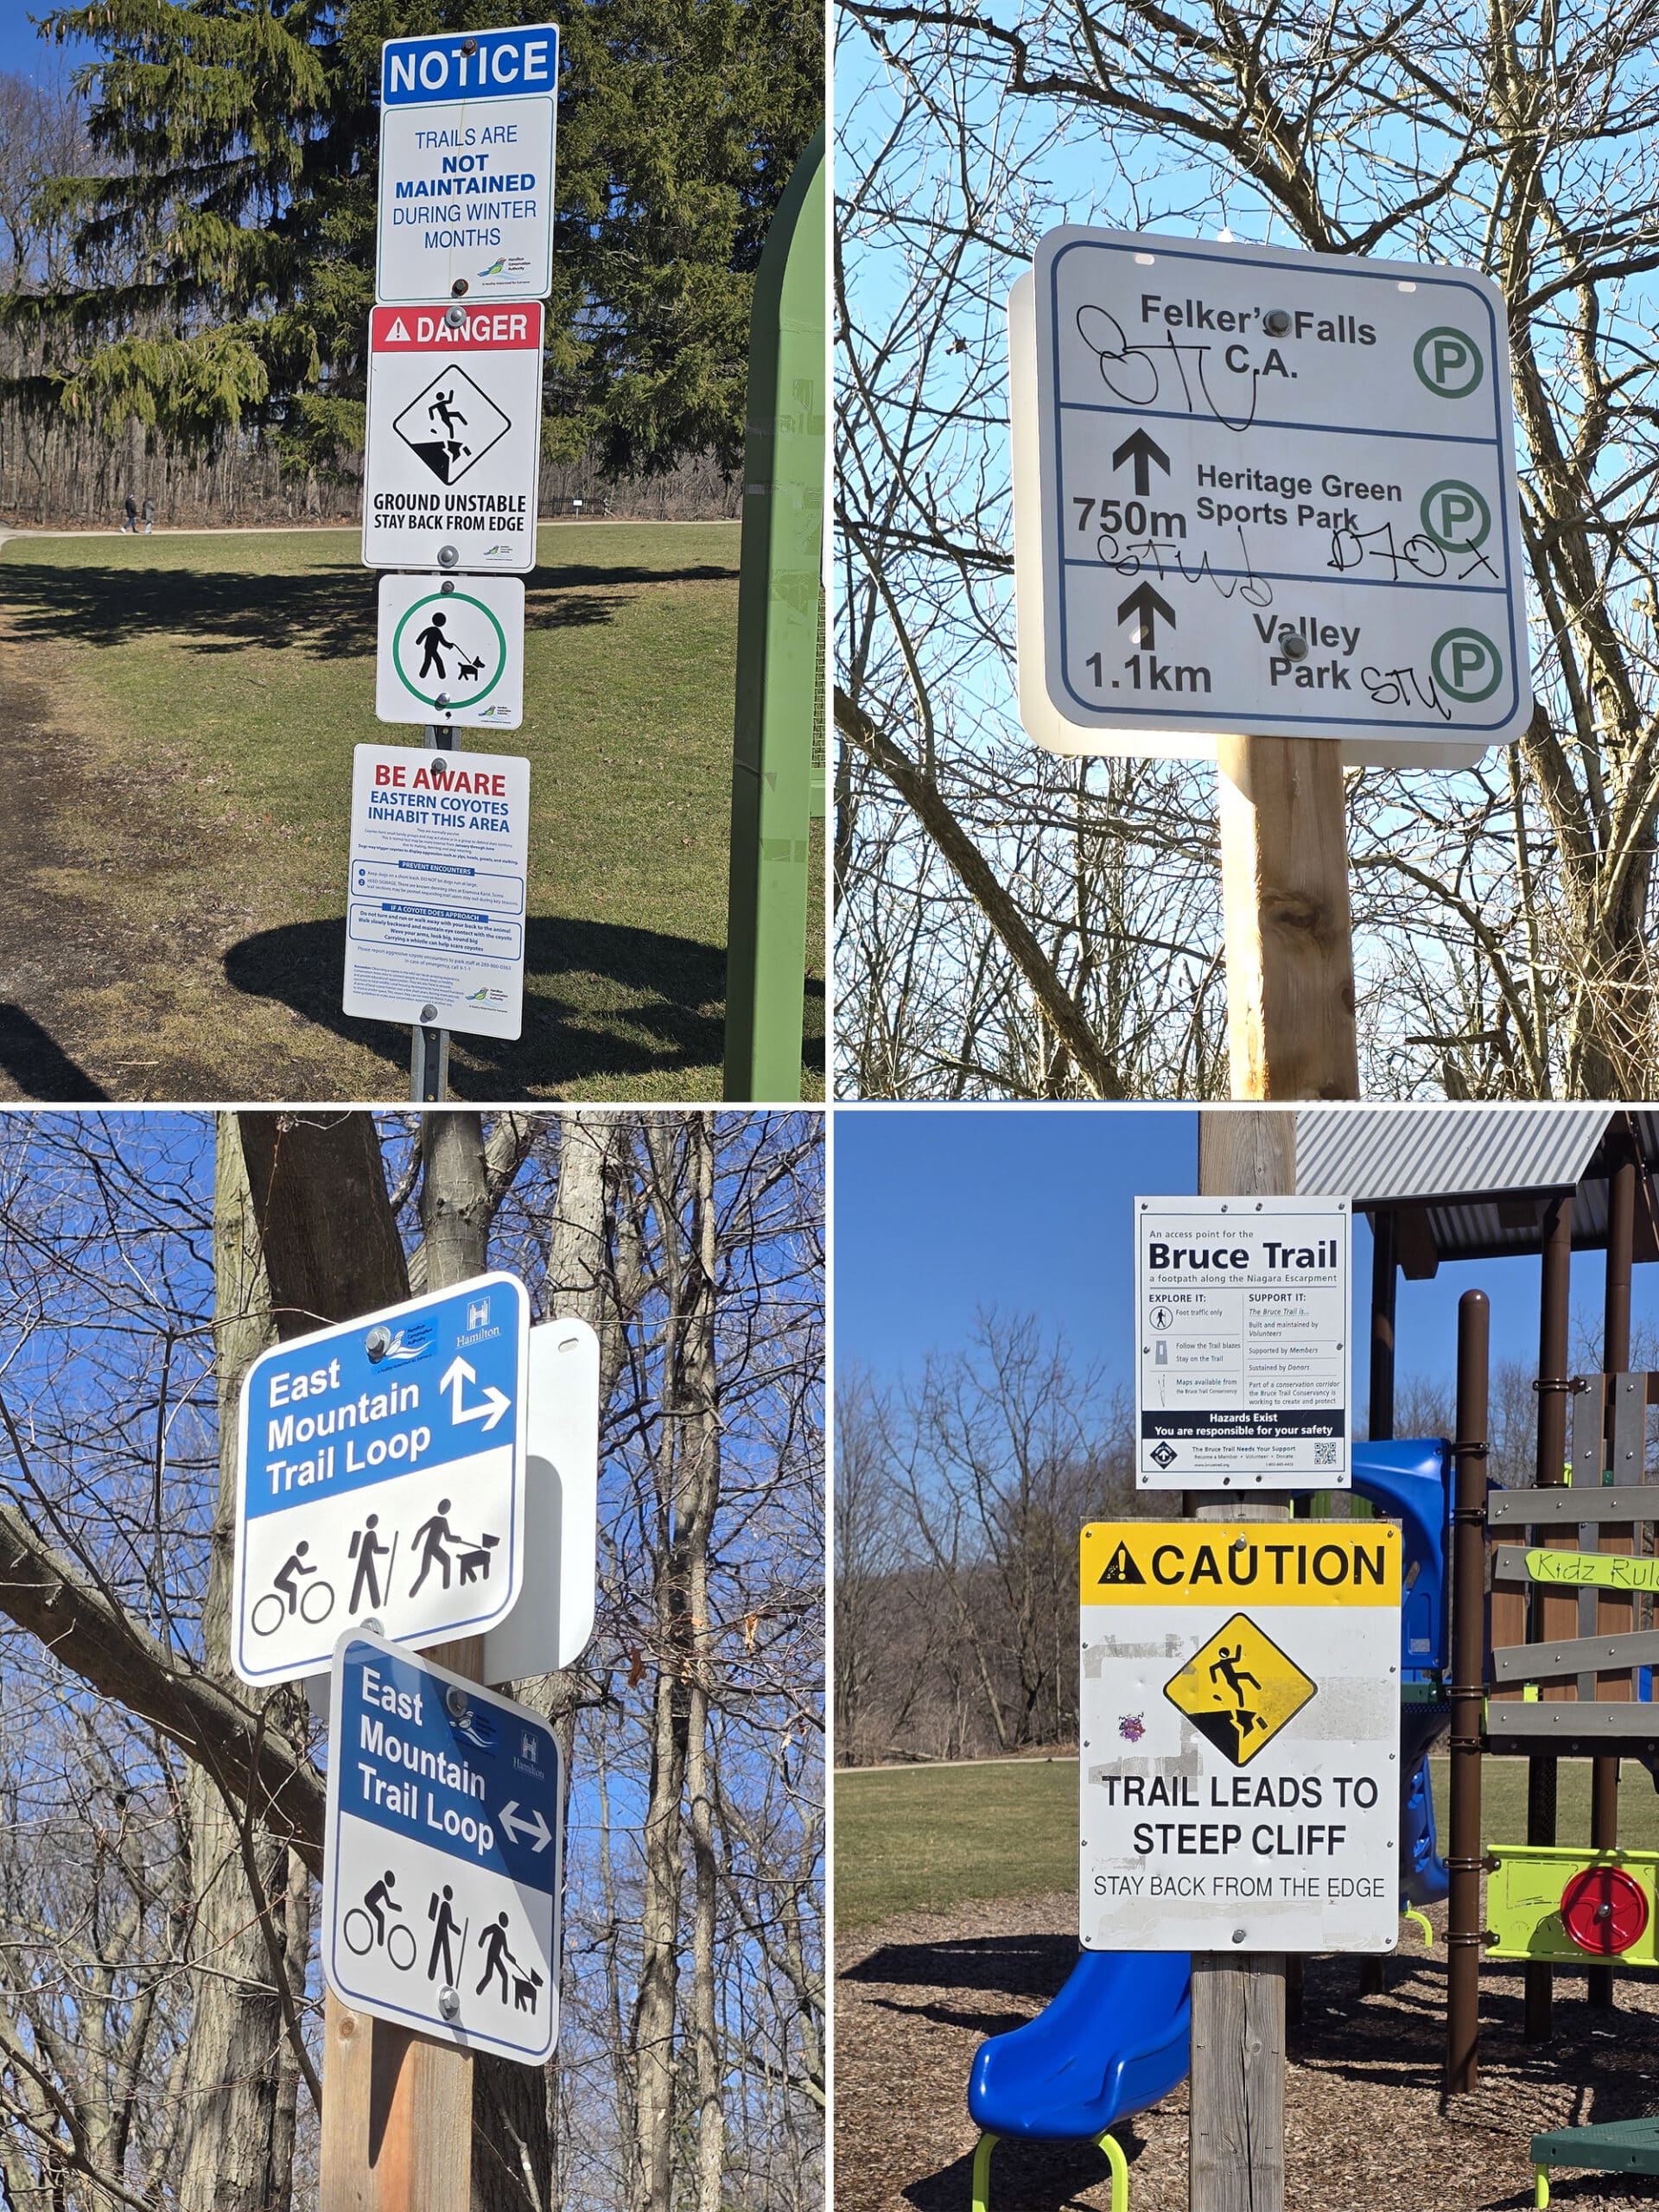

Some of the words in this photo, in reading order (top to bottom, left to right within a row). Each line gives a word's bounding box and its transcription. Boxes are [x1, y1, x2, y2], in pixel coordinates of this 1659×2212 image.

[391, 41, 548, 92] NOTICE
[415, 128, 476, 149] TRAILS
[480, 124, 518, 145] ARE
[442, 154, 489, 173] NOT
[396, 174, 536, 199] MAINTAINED
[393, 205, 461, 225] DURING
[467, 200, 536, 222] WINTER
[425, 228, 501, 249] MONTHS
[417, 315, 527, 342] DANGER
[1141, 295, 1284, 338] Felker'
[1294, 311, 1376, 346] Falls
[1224, 345, 1299, 378] C.A.
[1198, 465, 1312, 500] Heritage
[1322, 474, 1402, 502] Green
[374, 493, 440, 511] GROUND
[445, 495, 525, 512] UNSTABLE
[1197, 497, 1288, 526] Sports
[1298, 505, 1358, 531] Park
[374, 514, 403, 529] STAY
[409, 515, 442, 530] BACK
[447, 516, 485, 531] FROM
[489, 517, 524, 531] EDGE
[1072, 497, 1187, 538] 750m
[1253, 613, 1361, 656] Valley
[1085, 652, 1211, 693] 1.1km
[1270, 657, 1351, 690] Park
[376, 765, 406, 787] BE
[413, 768, 505, 797] AWARE
[371, 791, 436, 809] EASTERN
[441, 797, 508, 816] COYOTES
[368, 807, 429, 824] INHABIT
[432, 813, 465, 828] THIS
[469, 817, 510, 833] AREA
[403, 861, 429, 870] PREVENT
[430, 865, 471, 874] ENCOUNTERS
[446, 912, 479, 920] APPROACH
[1196, 1230, 1219, 1239] point
[1149, 1243, 1249, 1269] Bruce
[1263, 1240, 1337, 1268] Trail
[1158, 1274, 1198, 1284] footpath
[1201, 1274, 1225, 1284] along
[1248, 1274, 1281, 1283] Niagara
[1286, 1274, 1337, 1283] Escarpment
[1249, 1294, 1292, 1302] SUPPORT
[456, 1326, 499, 1347] Hamilton
[270, 1357, 340, 1408] East
[268, 1382, 420, 1452] Mountain
[1210, 1413, 1250, 1422] Hazards
[1253, 1413, 1278, 1422] Exist
[1154, 1427, 1174, 1435] You
[1196, 1426, 1254, 1438] responsible
[1257, 1425, 1272, 1435] for
[1275, 1427, 1299, 1437] your
[1301, 1425, 1333, 1436] safety
[265, 1446, 334, 1495] Trail
[346, 1427, 431, 1472] Loop
[1152, 1544, 1385, 1586] CAUTION
[1537, 1554, 1595, 1580] Kidz
[361, 1666, 423, 1726] East
[360, 1714, 486, 1801] Mountain
[1102, 1776, 1198, 1807] TRAIL
[1211, 1777, 1323, 1808] LEADS
[1333, 1777, 1378, 1808] TO
[358, 1763, 417, 1820] Trail
[427, 1793, 494, 1856] Loop
[1134, 1823, 1241, 1854] STEEP
[1252, 1824, 1346, 1855] CLIFF
[1094, 1876, 1146, 1896] STAY
[1150, 1876, 1205, 1897] BACK
[1213, 1877, 1273, 1897] FROM
[1279, 1877, 1319, 1897] THE
[1327, 1878, 1385, 1897] EDGE
